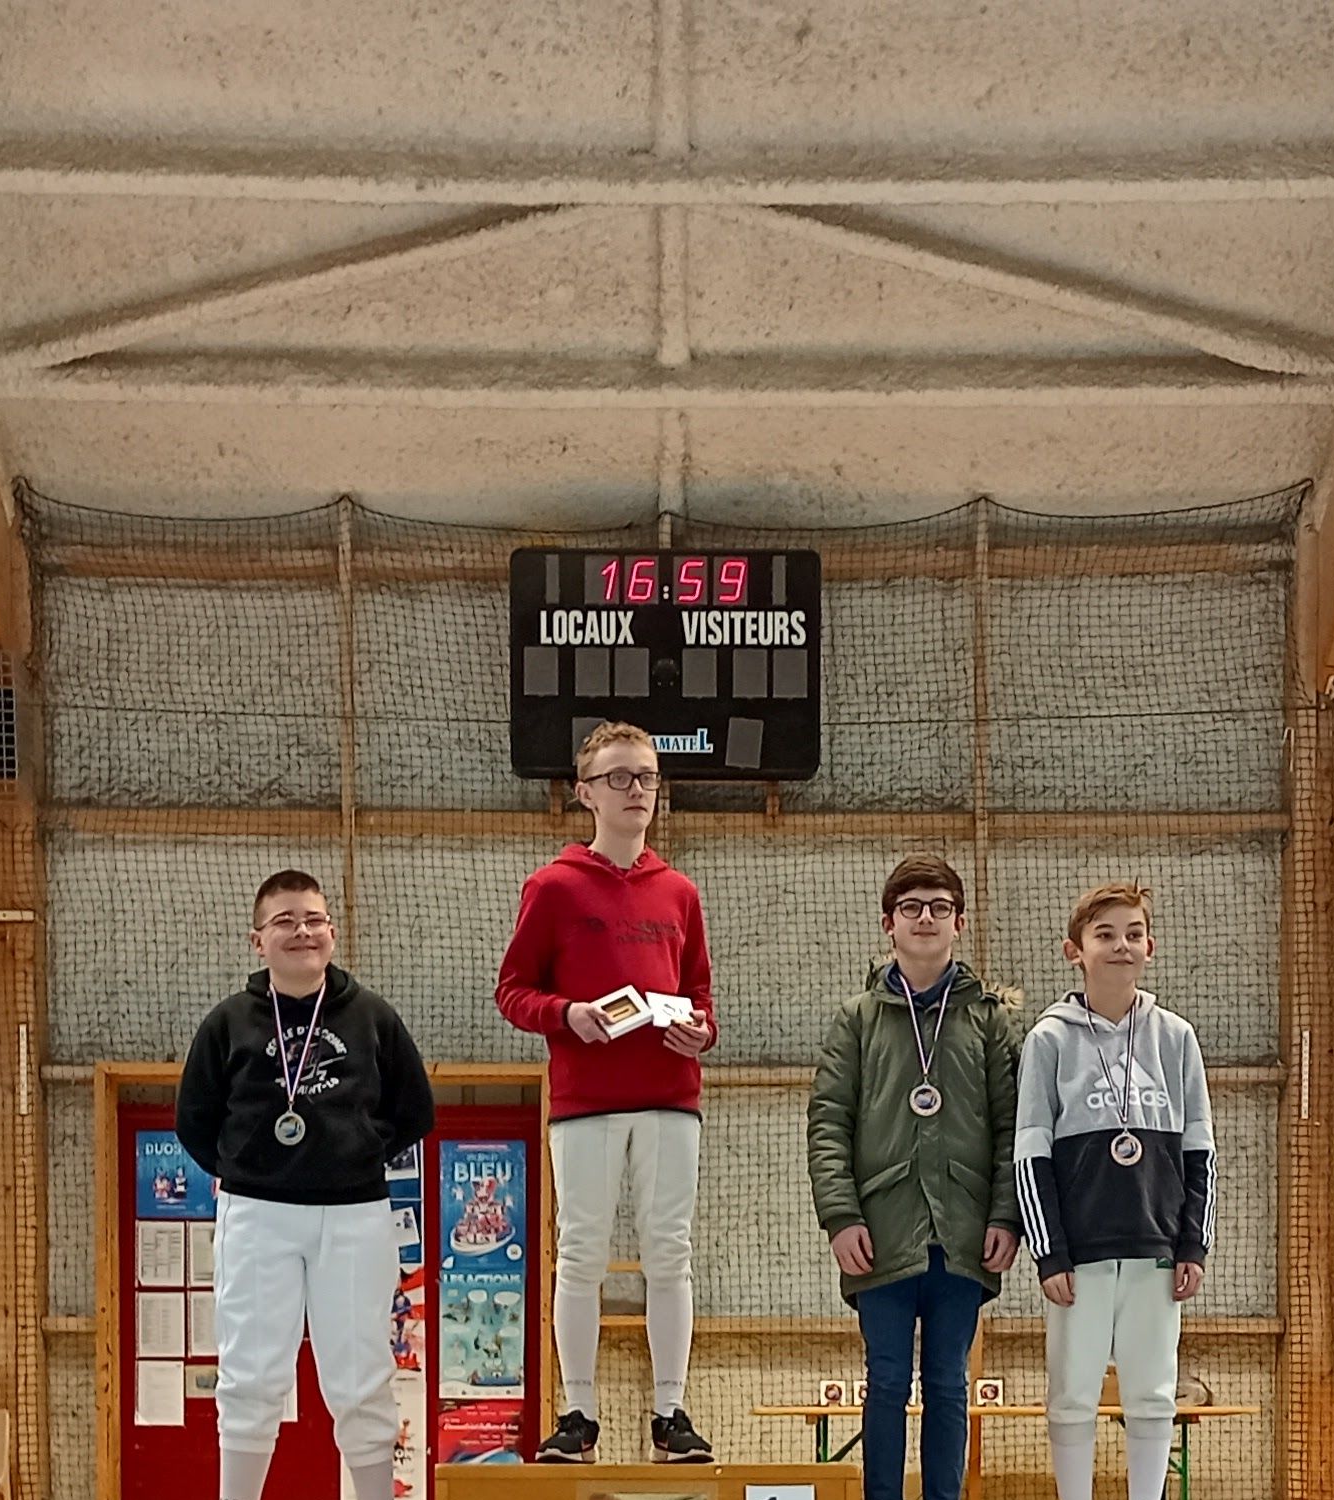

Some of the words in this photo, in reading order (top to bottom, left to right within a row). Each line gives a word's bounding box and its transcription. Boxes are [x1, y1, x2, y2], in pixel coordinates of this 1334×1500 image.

[601, 560, 747, 602] 16:59
[540, 610, 635, 645] LOCAUX
[681, 610, 807, 646] VISITEURS
[651, 730, 711, 751] AMATEL
[1087, 1085, 1167, 1110] addas
[454, 1160, 513, 1184] BLEU
